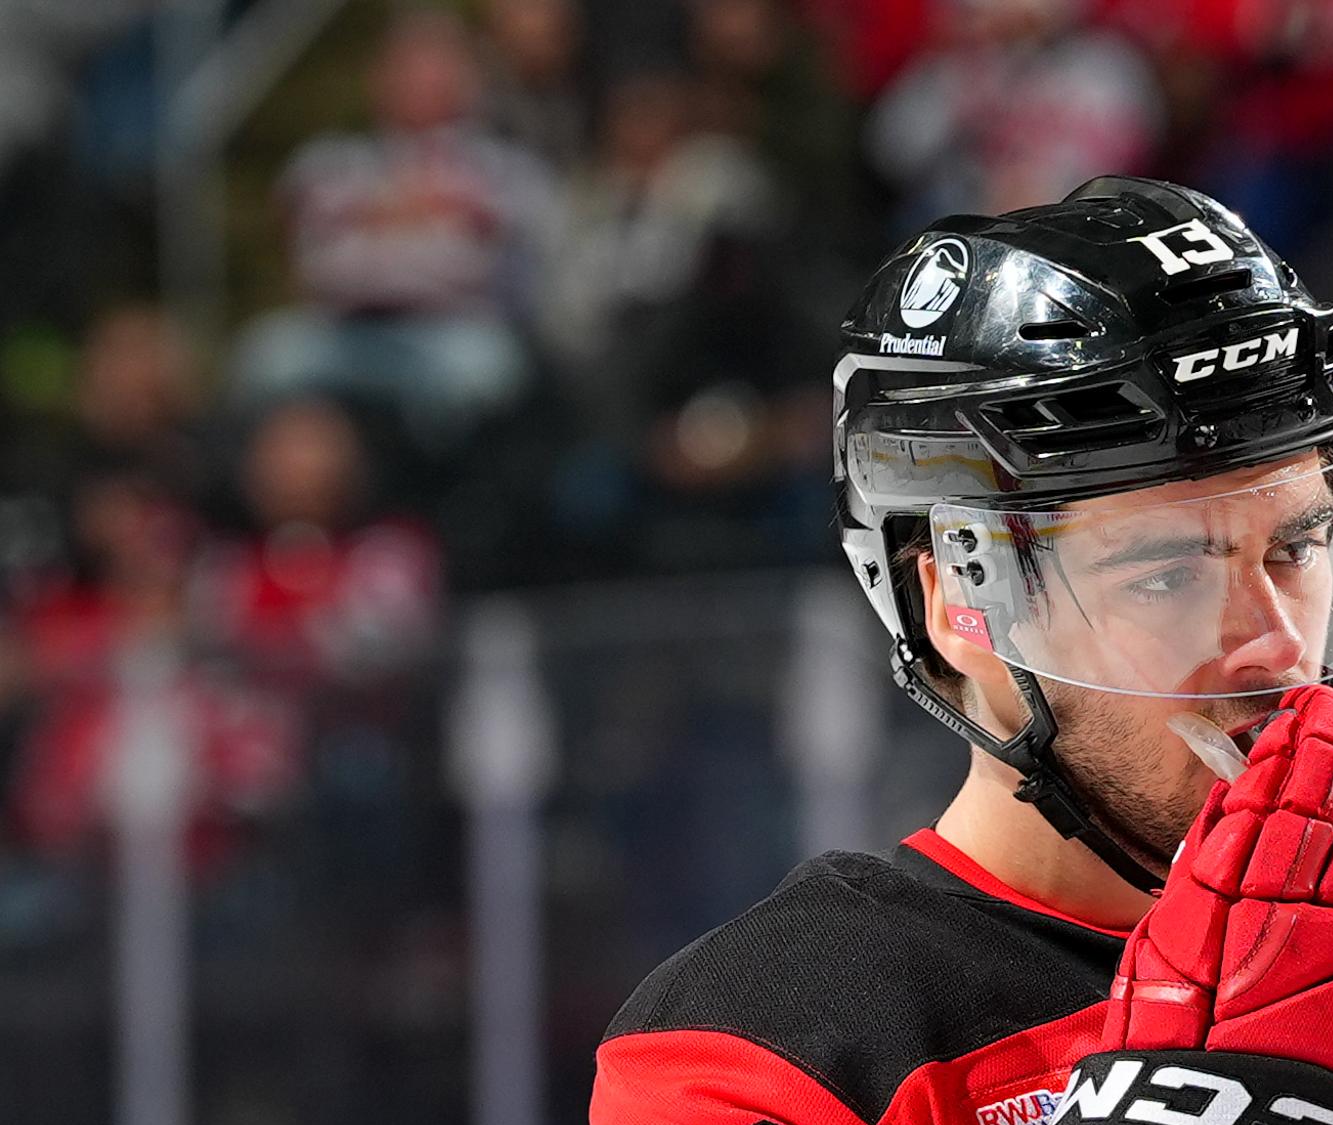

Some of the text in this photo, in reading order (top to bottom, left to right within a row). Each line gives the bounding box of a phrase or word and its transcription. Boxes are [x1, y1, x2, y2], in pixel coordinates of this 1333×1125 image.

[1126, 218, 1234, 276] 13
[879, 332, 947, 356] Prudential
[1172, 327, 1299, 383] CCM
